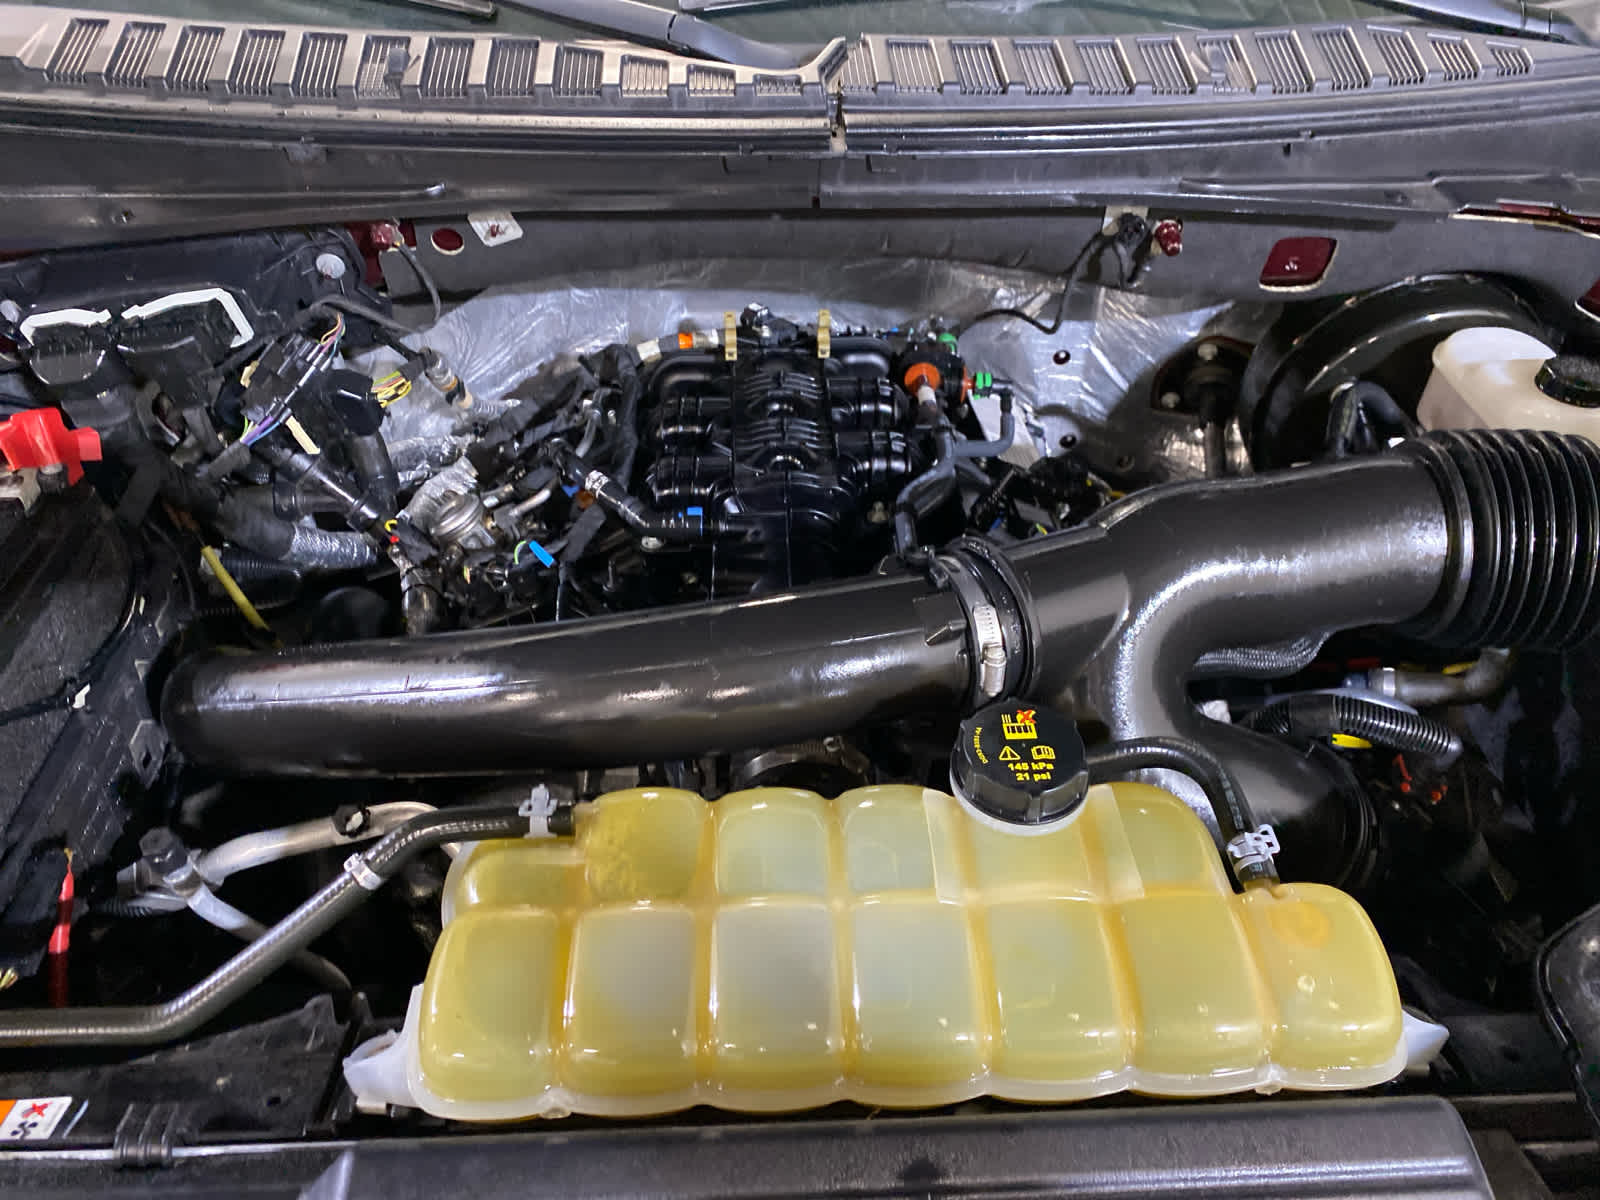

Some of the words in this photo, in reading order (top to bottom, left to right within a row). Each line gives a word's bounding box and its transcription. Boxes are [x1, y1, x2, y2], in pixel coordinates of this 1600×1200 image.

[1008, 762, 1029, 771] 145
[1031, 762, 1054, 770] kPa
[1016, 772, 1030, 781] 21
[1033, 772, 1052, 782] psi
